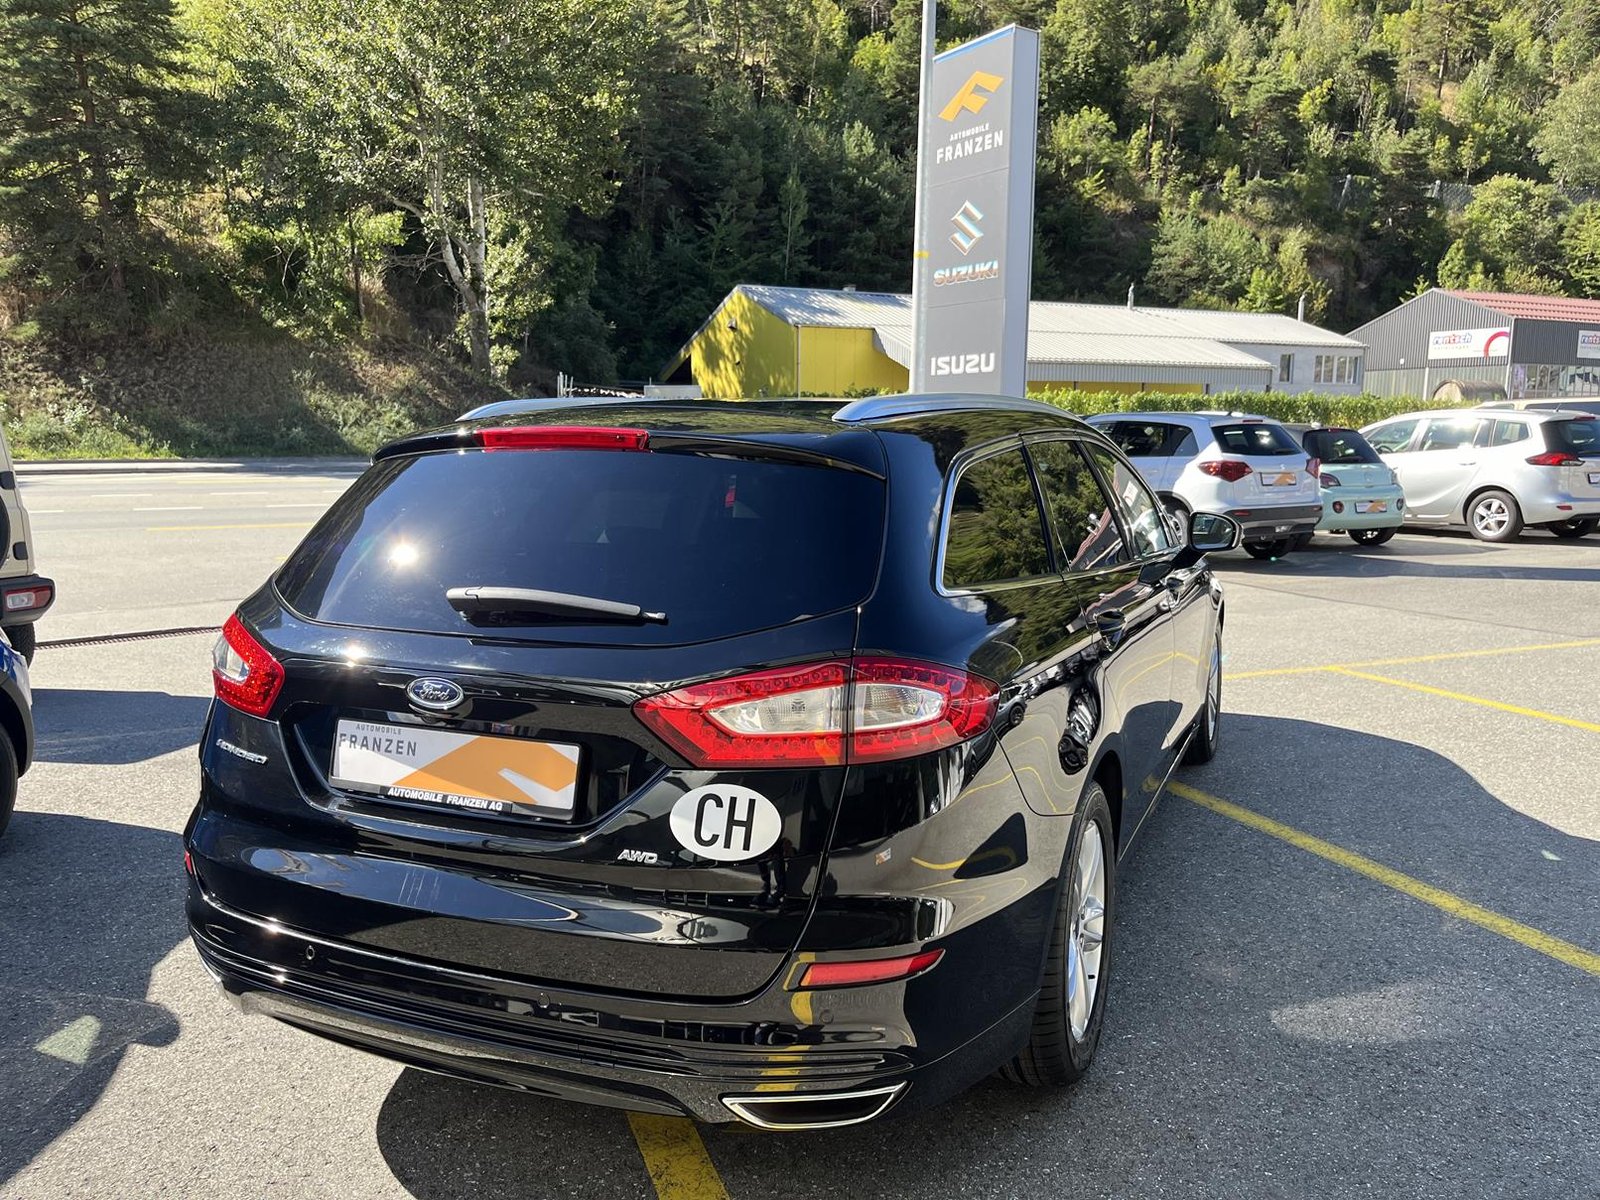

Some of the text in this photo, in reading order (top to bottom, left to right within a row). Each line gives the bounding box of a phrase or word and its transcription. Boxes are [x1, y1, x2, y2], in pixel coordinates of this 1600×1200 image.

[950, 122, 990, 142] AUTOMOBILE
[936, 130, 1004, 165] FRANZEN
[933, 260, 999, 287] SUZUKI
[930, 352, 995, 377] ISUZU
[415, 681, 451, 701] Ford
[355, 723, 402, 736] AUTOMOBILE
[338, 733, 418, 758] FRANZEN
[387, 787, 504, 812] AUTOMOBILE FRANZEN AG
[694, 792, 757, 852] CH
[617, 848, 658, 864] AWD
